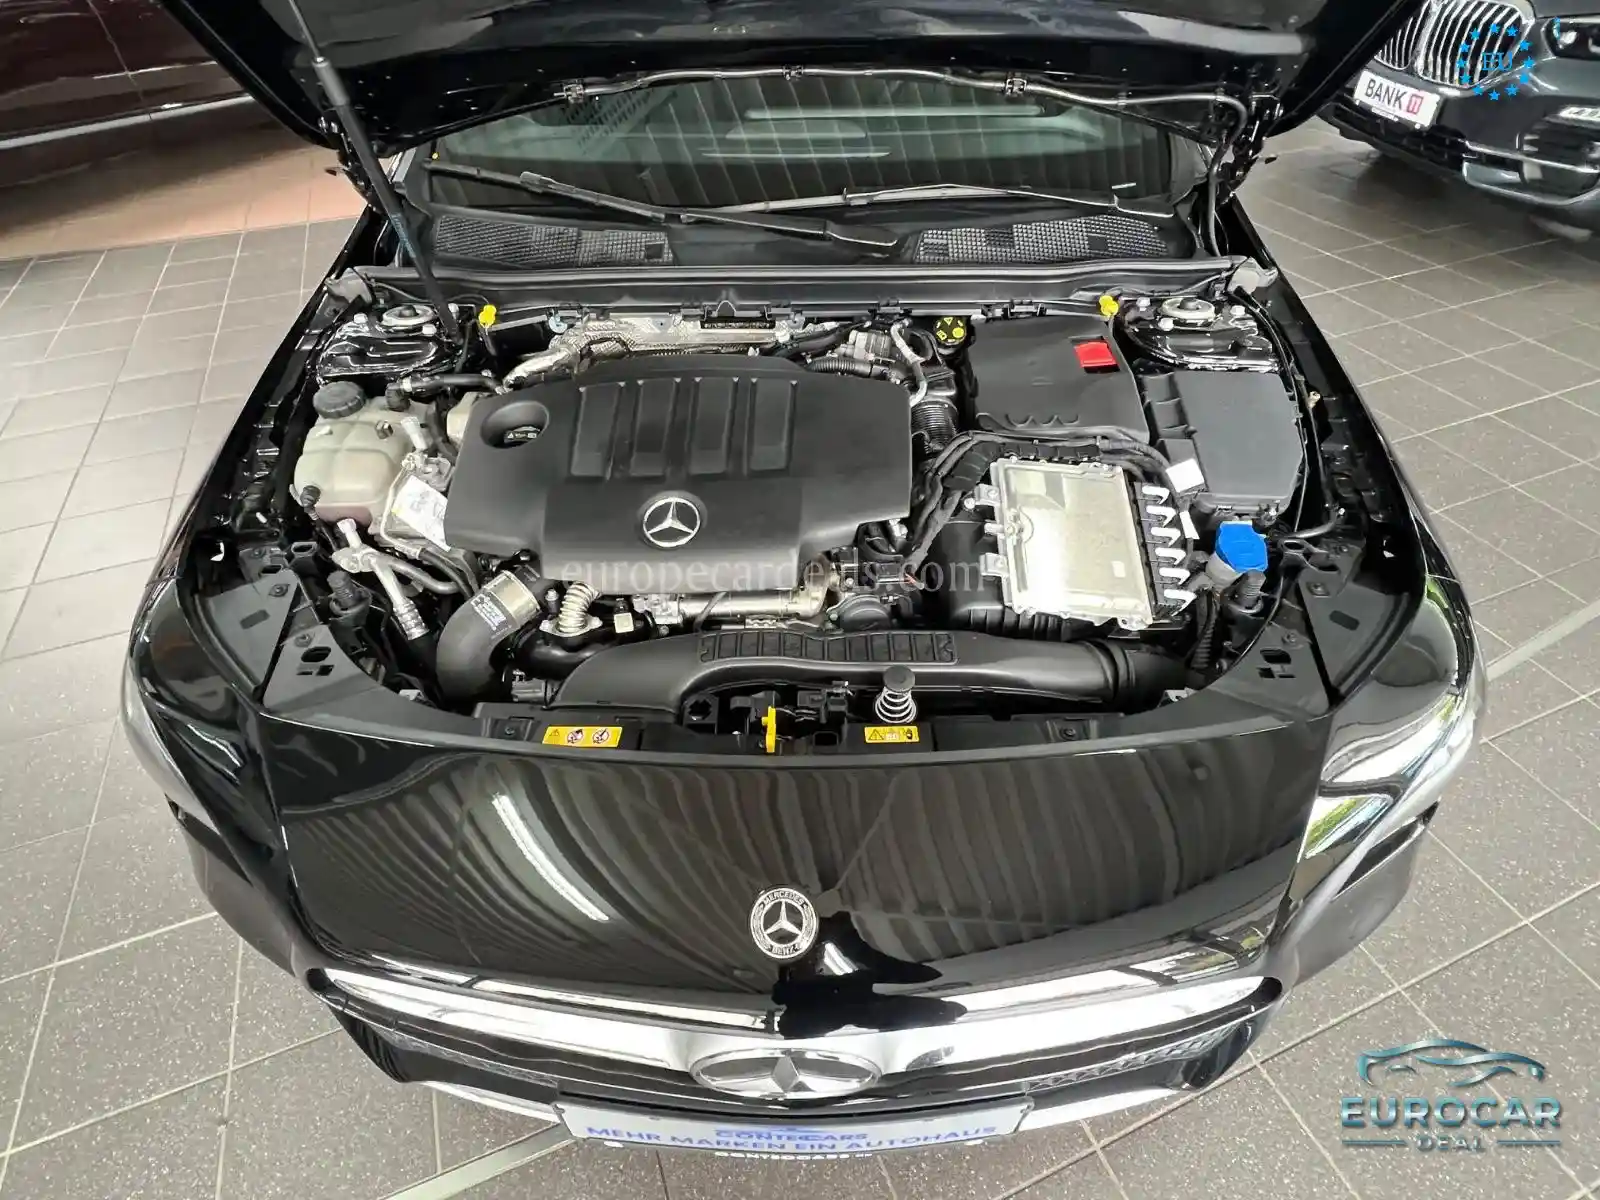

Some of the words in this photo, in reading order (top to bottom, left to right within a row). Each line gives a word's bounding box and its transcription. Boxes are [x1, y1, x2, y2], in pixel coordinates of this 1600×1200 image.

[1364, 78, 1408, 111] BANK
[586, 1126, 662, 1142] MEHR
[670, 1135, 786, 1150] MARKEN
[795, 1142, 836, 1150] EIN
[846, 1126, 998, 1149] AUTOHAUS
